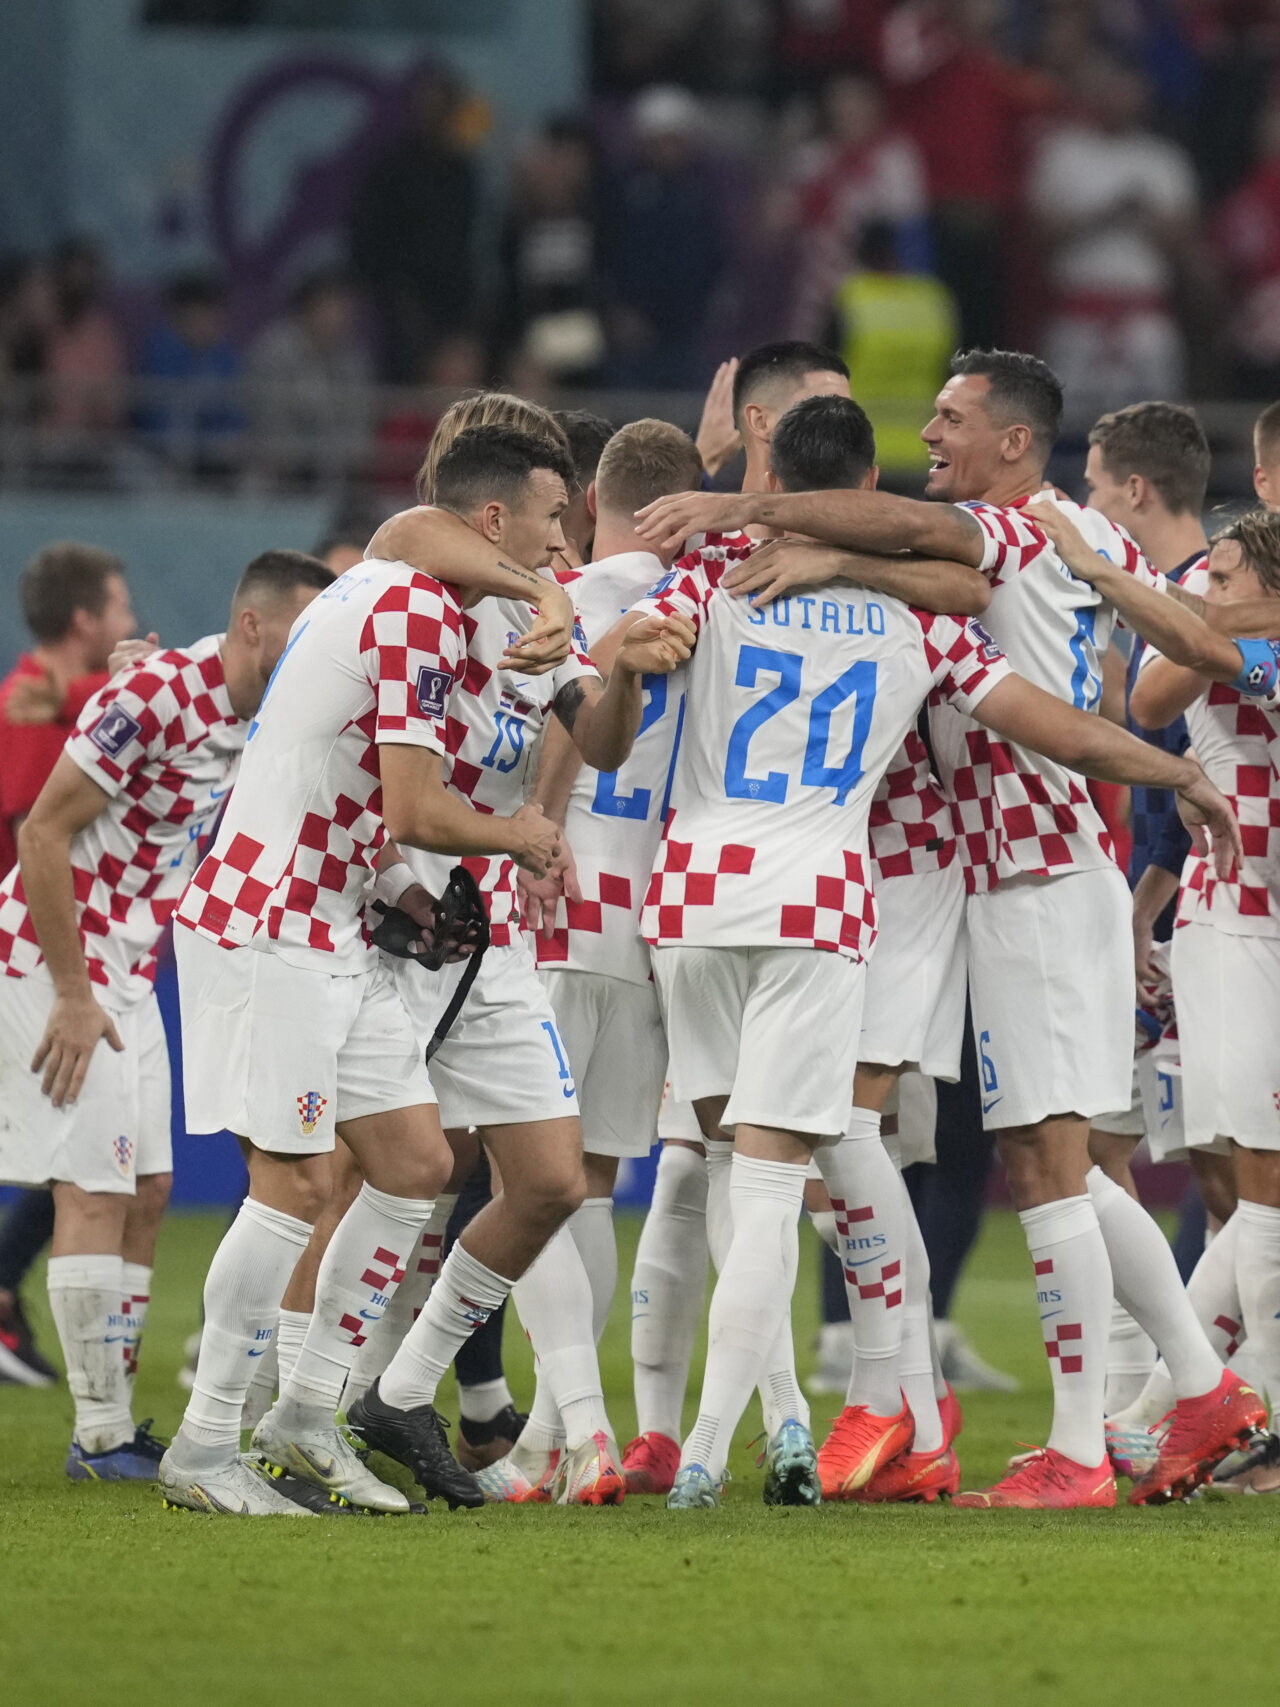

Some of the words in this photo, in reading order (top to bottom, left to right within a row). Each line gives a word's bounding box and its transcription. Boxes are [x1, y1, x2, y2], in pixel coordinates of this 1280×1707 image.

[480, 711, 526, 773] 19
[591, 673, 688, 823] 2
[724, 644, 865, 807] 24
